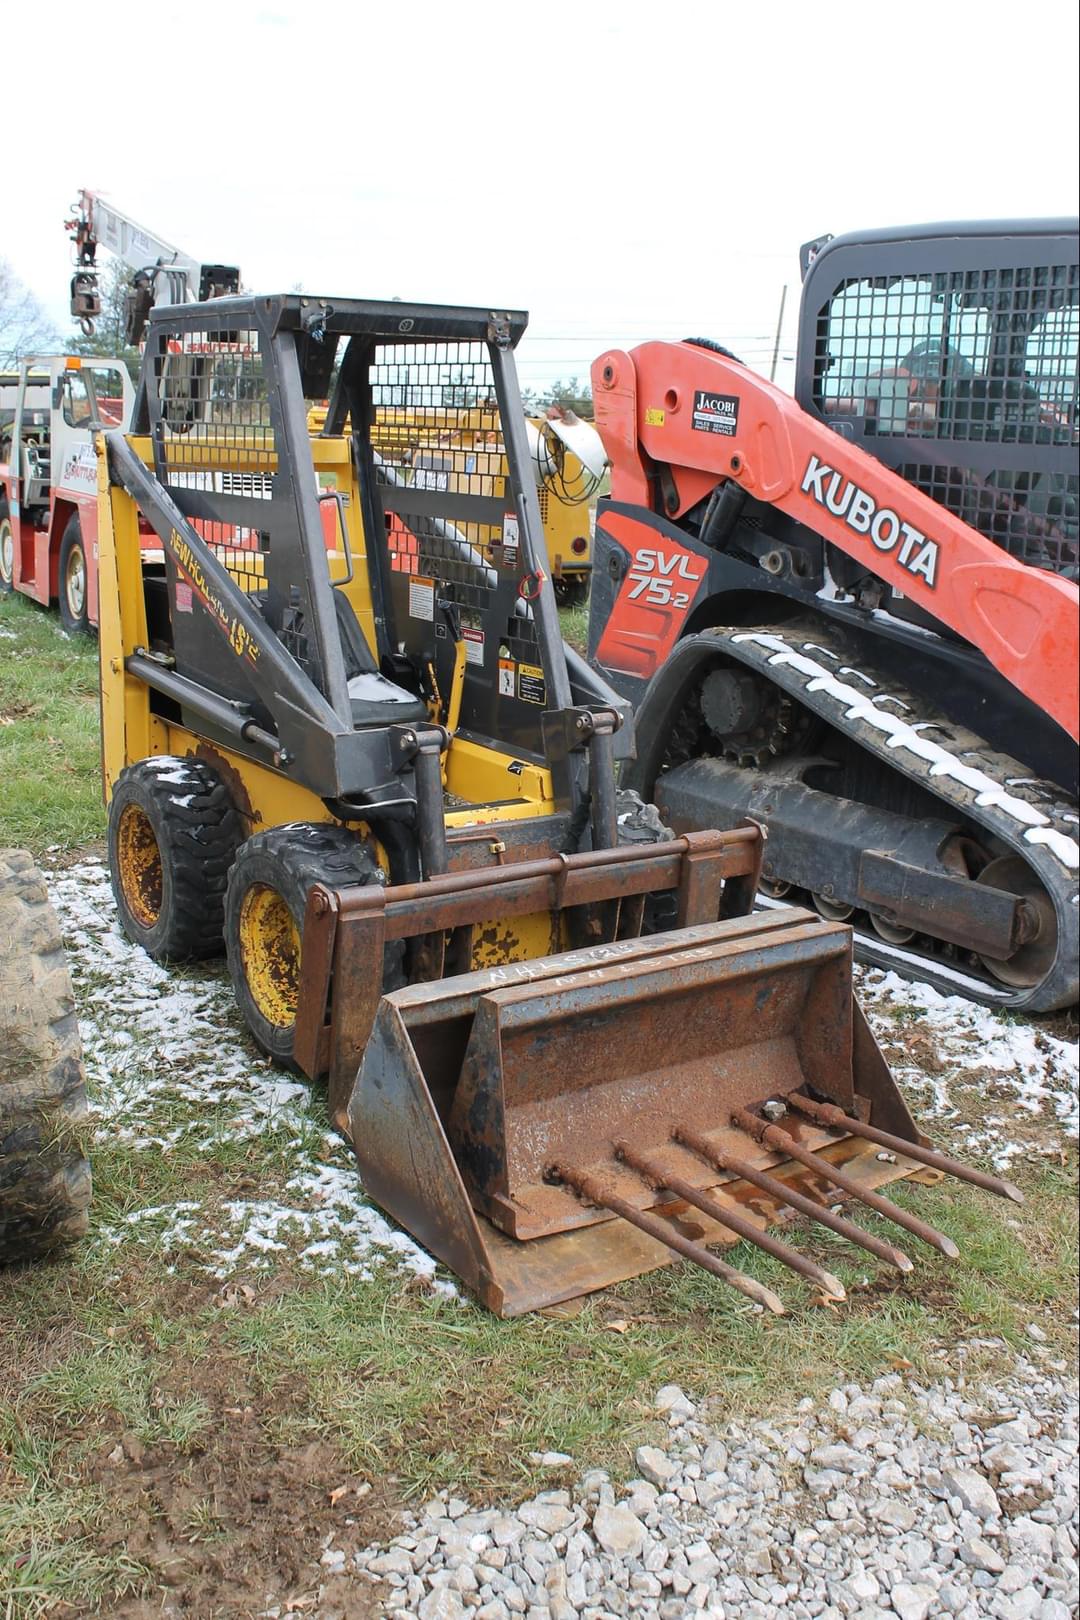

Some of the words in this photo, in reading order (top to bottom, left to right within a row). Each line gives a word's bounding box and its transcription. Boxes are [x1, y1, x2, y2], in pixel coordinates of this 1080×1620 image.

[696, 392, 735, 413] JACOBI
[712, 428, 733, 436] RENTALS
[713, 423, 733, 431] SERVICE
[800, 455, 939, 588] KUBOTA
[632, 548, 699, 581] SVL
[626, 573, 689, 609] 75-2
